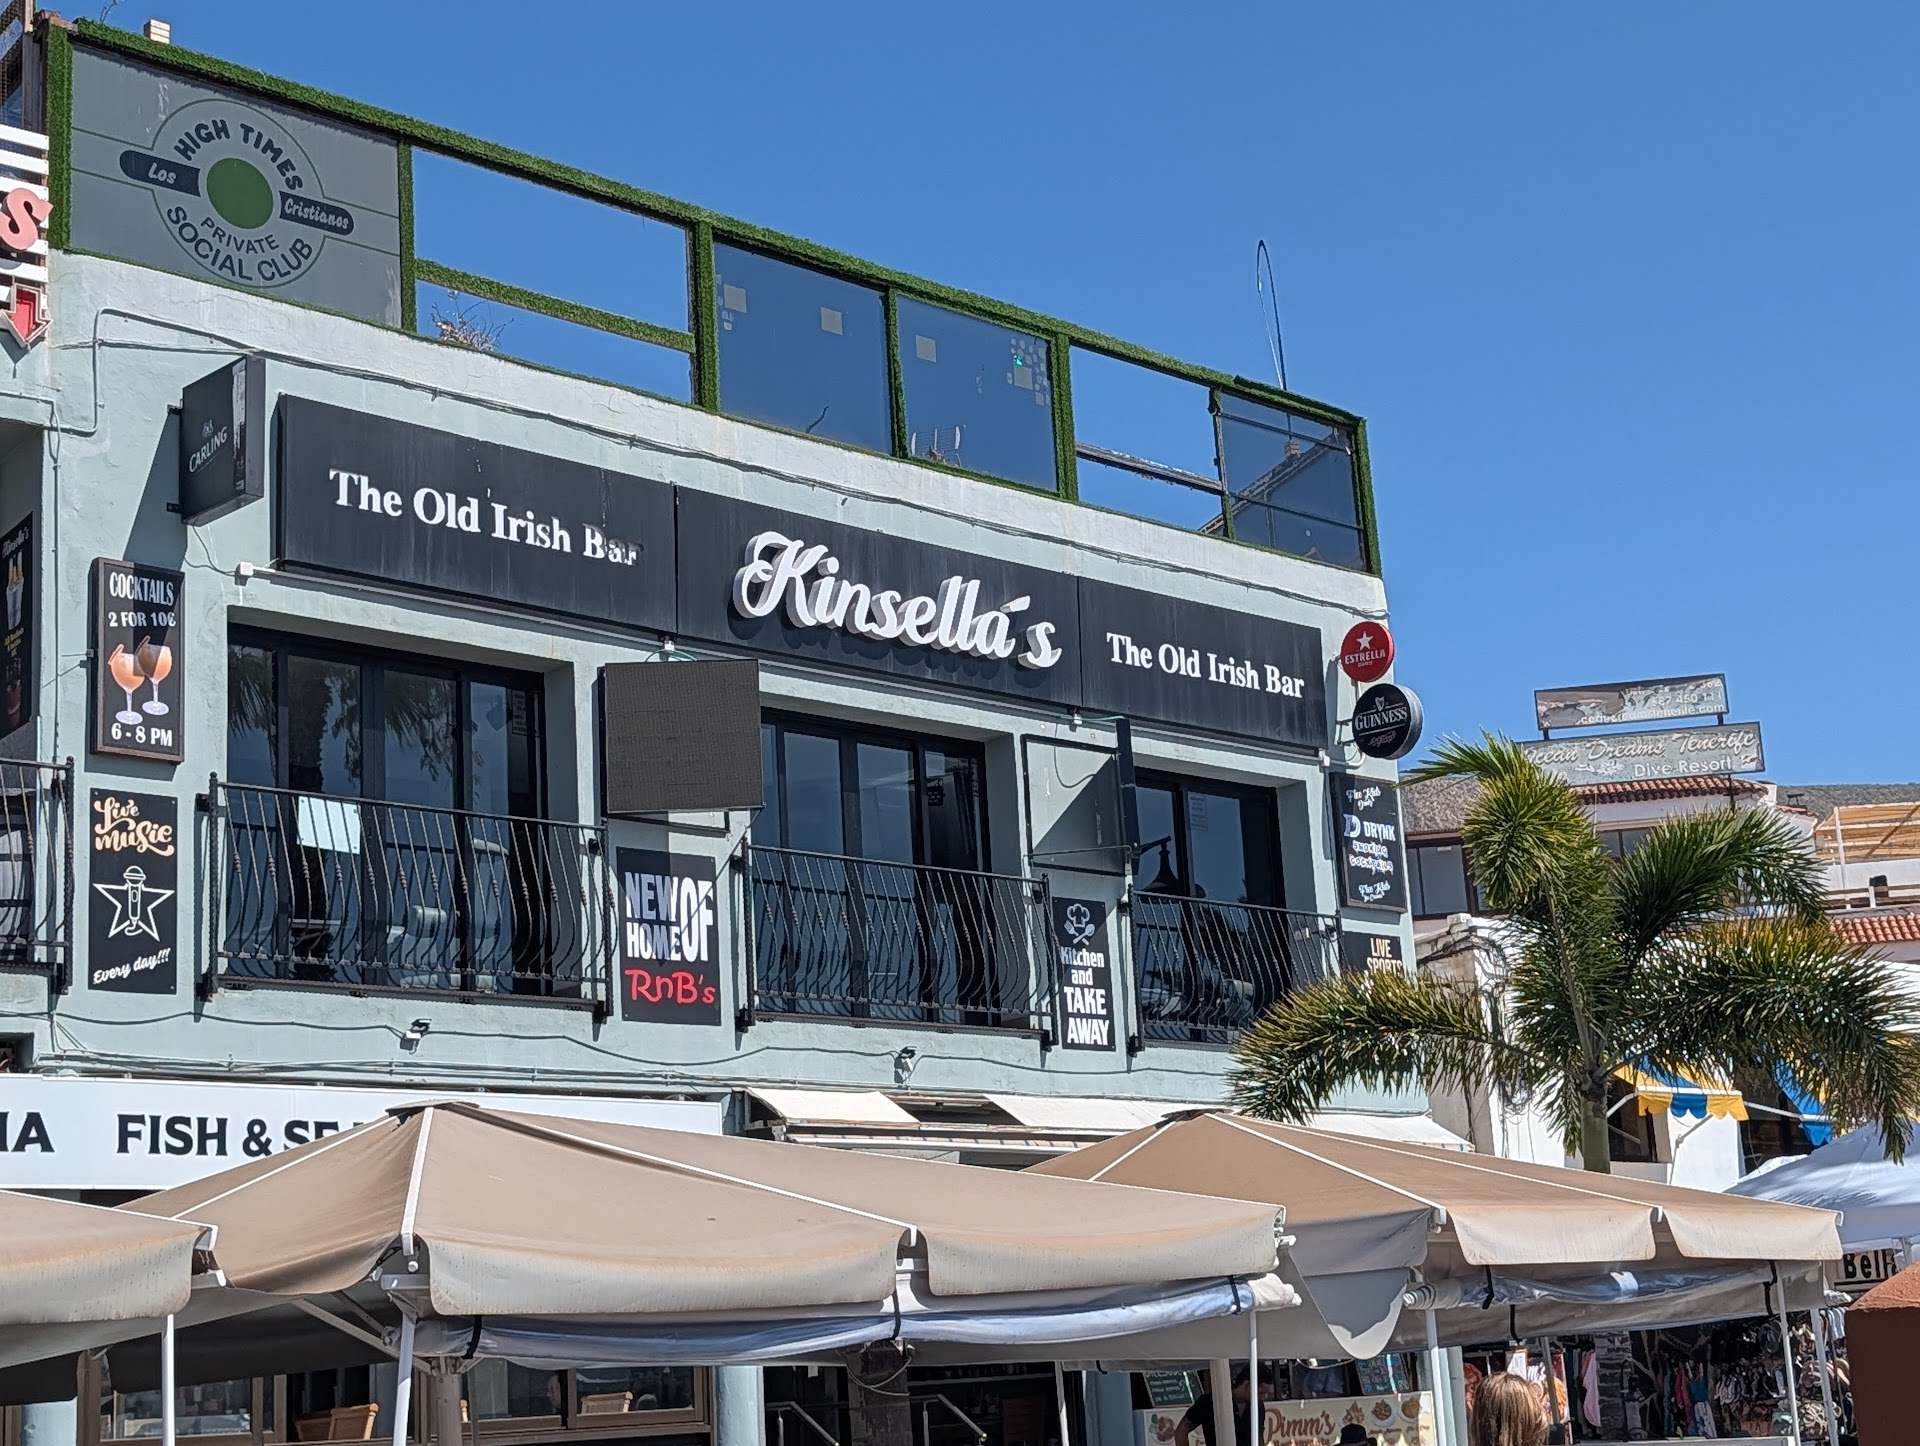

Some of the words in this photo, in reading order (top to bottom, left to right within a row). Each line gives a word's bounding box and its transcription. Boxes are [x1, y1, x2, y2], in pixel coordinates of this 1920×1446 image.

[173, 118, 231, 162] HIGH
[239, 122, 304, 191] TIMES
[148, 162, 177, 184] Los
[284, 199, 349, 230] Cristianos
[167, 205, 253, 281] SOCIAL
[257, 237, 313, 282] CLUB
[200, 216, 280, 255] PRIVATE
[189, 426, 228, 473] CARLING
[329, 468, 403, 517] The
[413, 487, 481, 533] Old
[490, 500, 572, 553] Irish
[582, 522, 645, 566] Bar
[109, 571, 174, 606] COCKTAILS
[108, 611, 118, 627] 2
[121, 611, 147, 627] FOR
[151, 611, 176, 627] 10€
[1106, 632, 1152, 669] The
[1158, 643, 1201, 678] Old
[1207, 652, 1260, 690] Irish
[1264, 664, 1305, 698] Bar
[1344, 649, 1386, 664] ESTRELLA
[1355, 707, 1408, 731] GUINNESS
[111, 723, 122, 740] 6
[136, 726, 146, 743] 8
[151, 728, 173, 747] PM
[1634, 762, 1673, 777] Dive
[1678, 756, 1732, 773] Resort
[94, 797, 139, 834] Live
[625, 872, 679, 922] NEW
[680, 877, 714, 962] OF
[626, 921, 682, 961] HOME
[1370, 937, 1392, 958] LIVE
[1061, 946, 1105, 968] Kitchen
[1366, 957, 1403, 976] SPORTS
[93, 963, 131, 984] Every
[624, 969, 716, 1004] RnB's
[1071, 968, 1093, 986] and
[1064, 986, 1107, 1015] TAKE
[1067, 1017, 1109, 1045] AWAY
[117, 1113, 229, 1156] FISH
[242, 1118, 272, 1157] &
